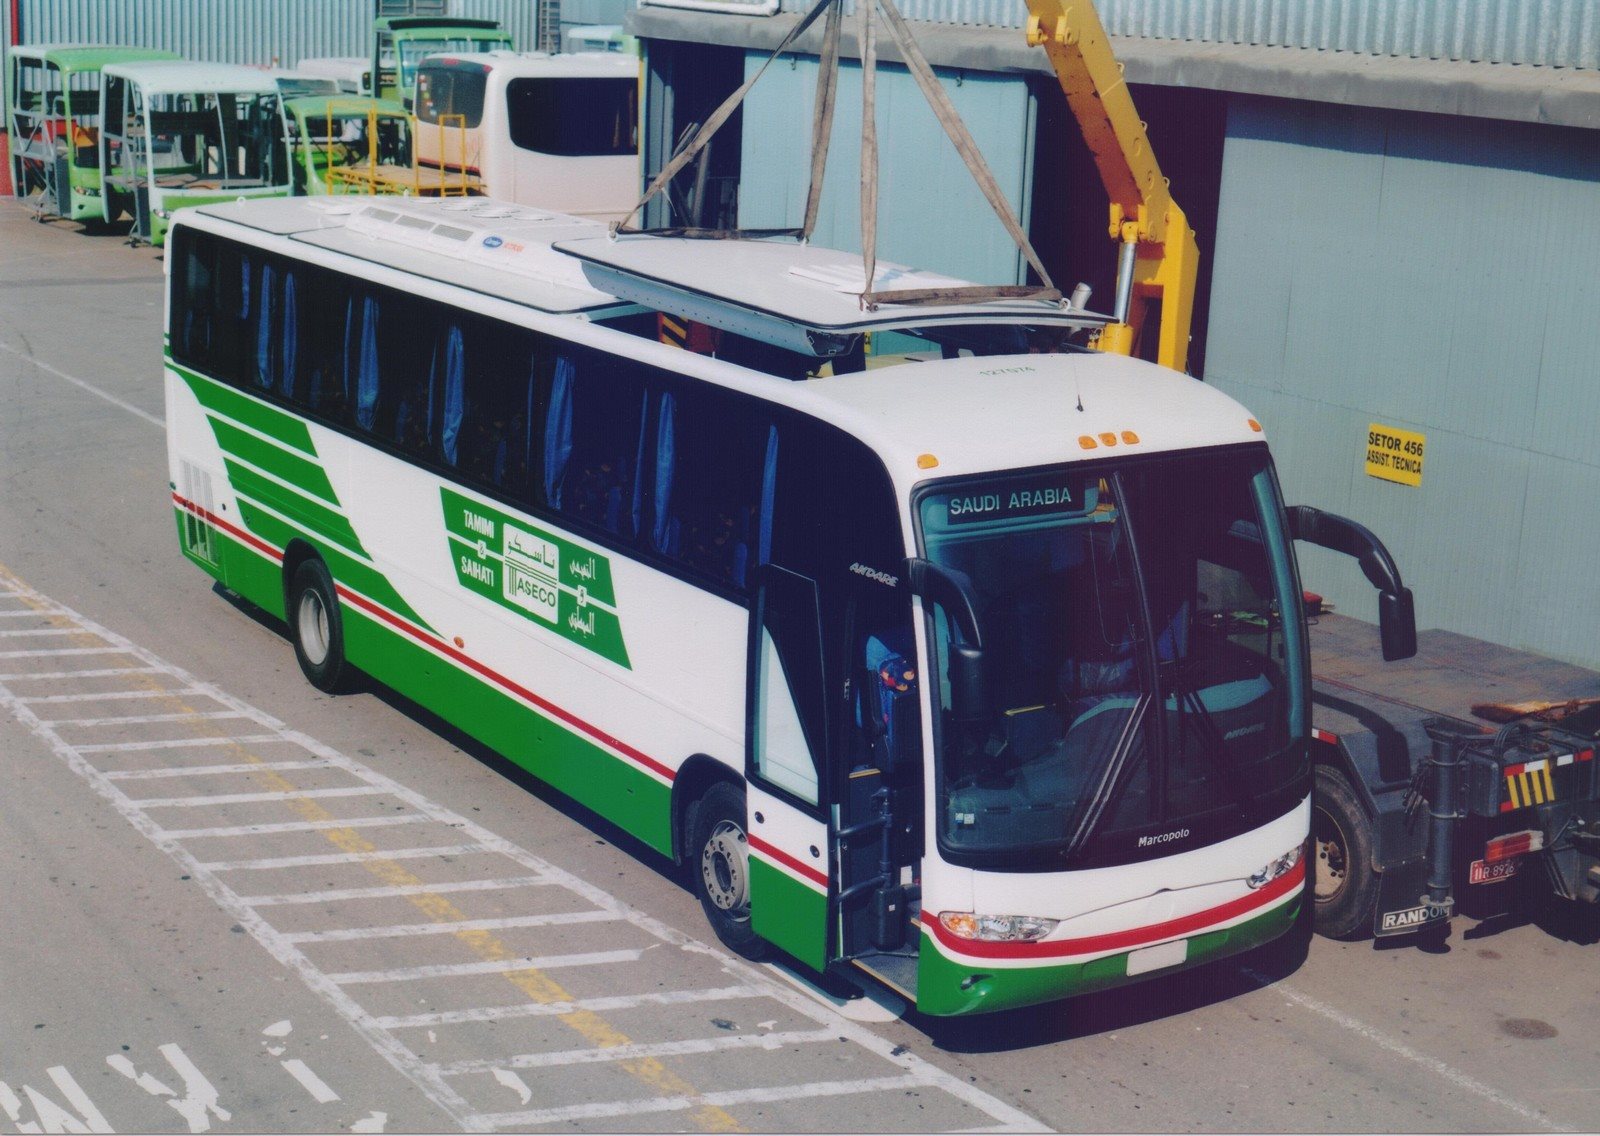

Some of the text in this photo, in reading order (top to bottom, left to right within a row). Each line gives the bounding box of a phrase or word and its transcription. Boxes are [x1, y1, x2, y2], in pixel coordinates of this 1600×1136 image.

[1368, 431, 1423, 456] SETOR 456
[1366, 449, 1421, 475] ASSIST. TECNICA
[950, 487, 1072, 515] SAUDI ARABIA
[463, 509, 495, 539] TAMIMI
[461, 556, 494, 587] SAIHATI
[849, 562, 899, 588] ANDARE
[1137, 828, 1190, 848] Marcopolo
[1384, 905, 1448, 927] RANDON
